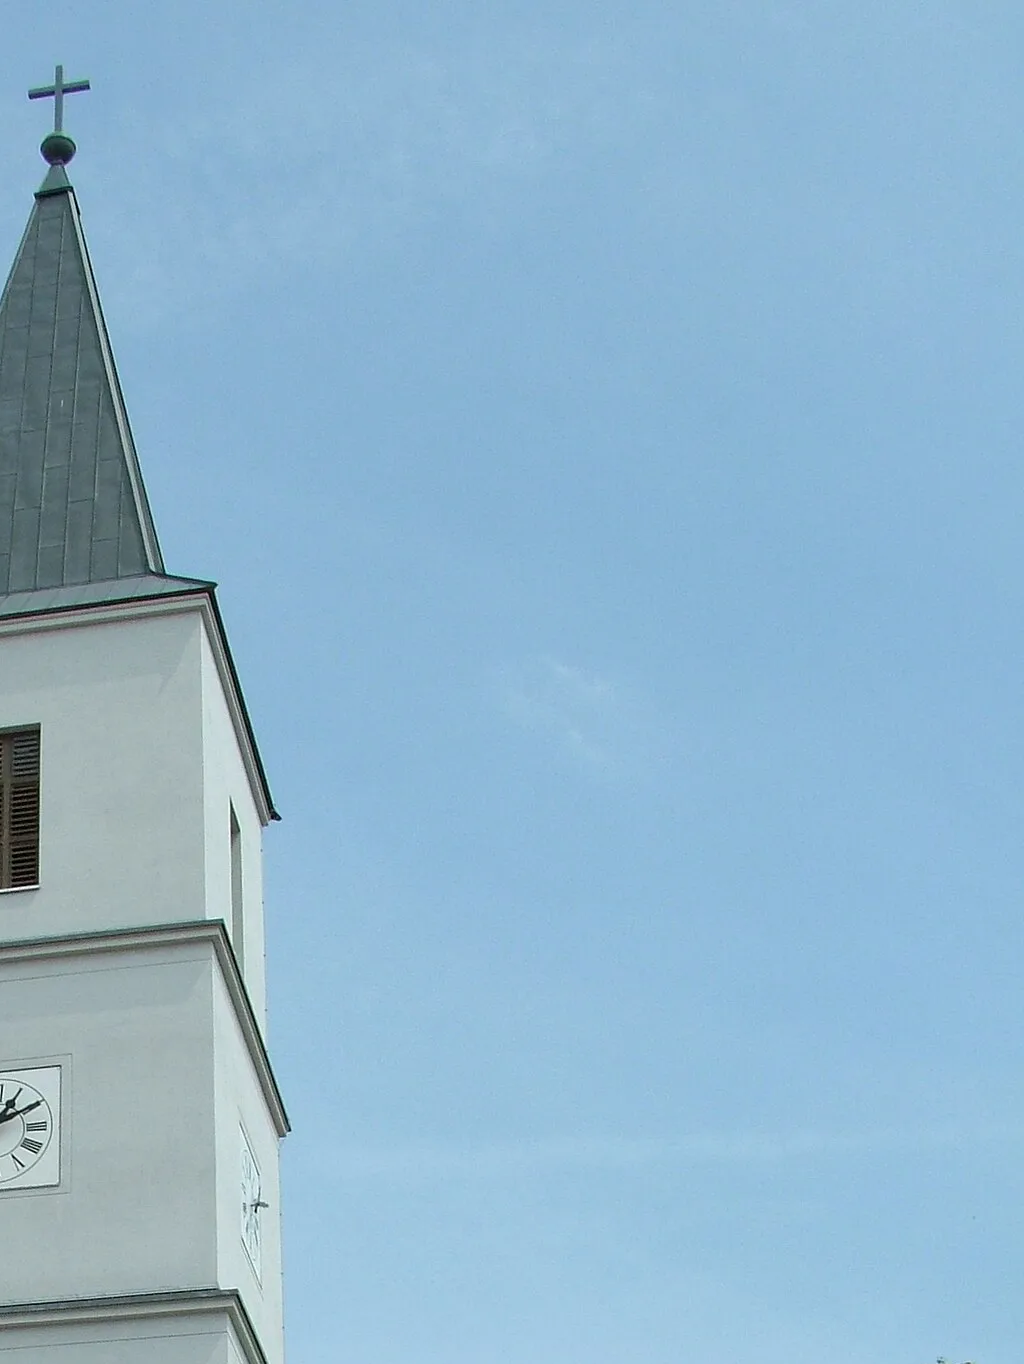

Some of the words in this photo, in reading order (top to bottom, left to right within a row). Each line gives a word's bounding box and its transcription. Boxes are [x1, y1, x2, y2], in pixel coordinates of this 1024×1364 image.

[26, 1121, 47, 1132] III
[20, 1138, 43, 1154] IIII
[11, 1154, 26, 1171] V
